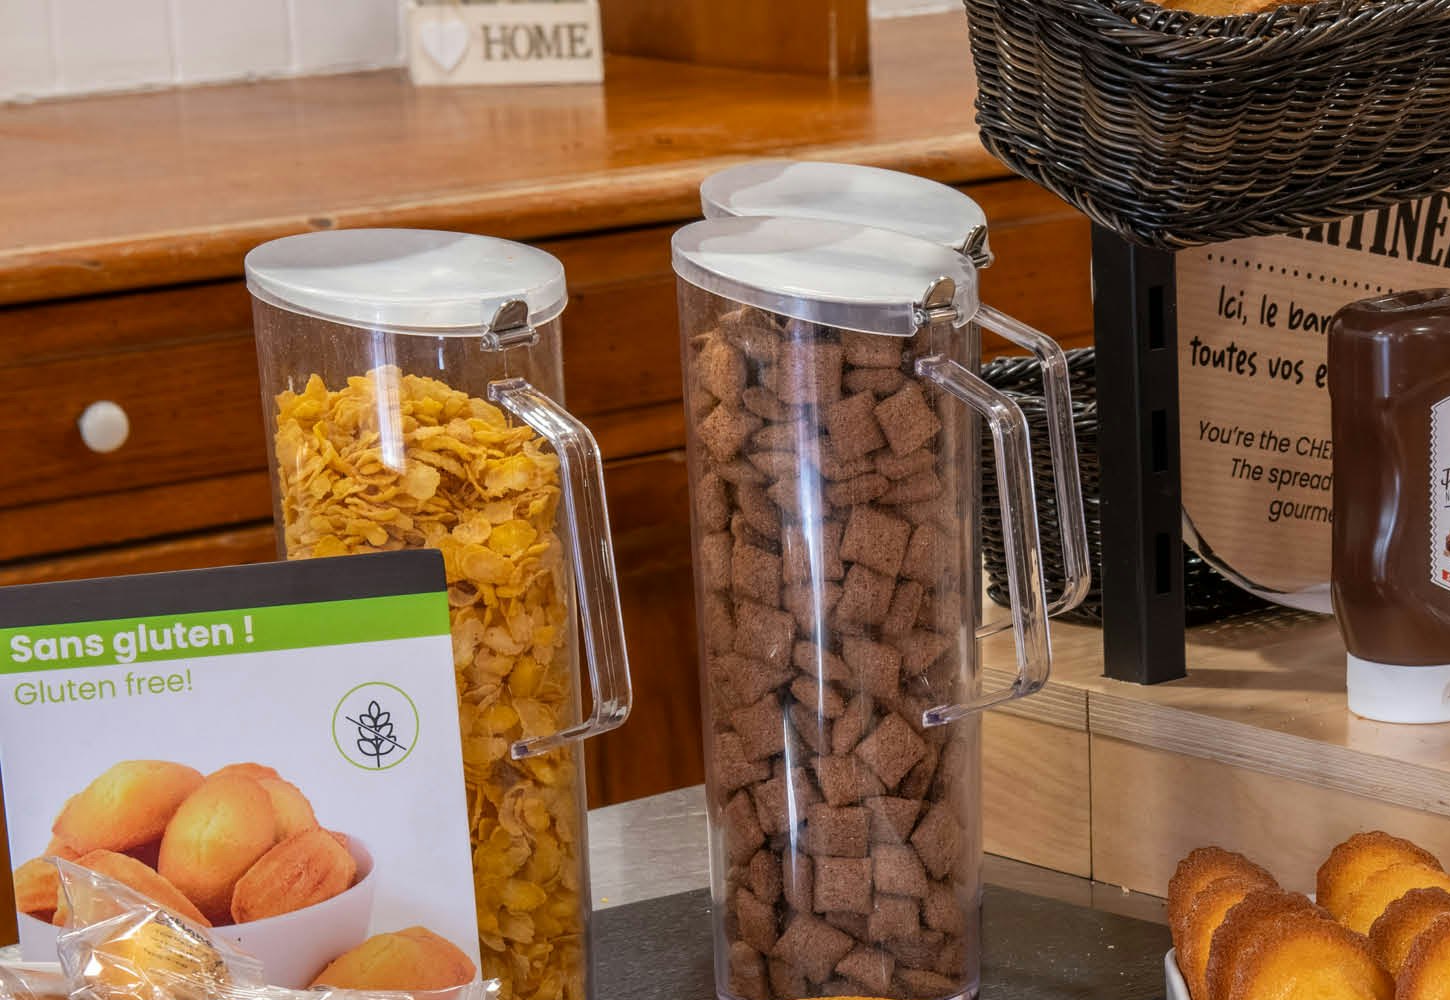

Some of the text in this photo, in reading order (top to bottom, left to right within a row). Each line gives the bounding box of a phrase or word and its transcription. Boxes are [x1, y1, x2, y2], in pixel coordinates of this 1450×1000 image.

[480, 23, 594, 62] HOME
[1217, 285, 1248, 326] Ici,
[1259, 294, 1278, 326] le
[1189, 335, 1258, 378] toutes
[1268, 356, 1305, 385] vos
[1259, 430, 1291, 453] the
[1296, 435, 1334, 460] CHE
[1231, 457, 1264, 481] The
[10, 615, 255, 664] Sans gluten !
[14, 668, 194, 705] Gluten free!
